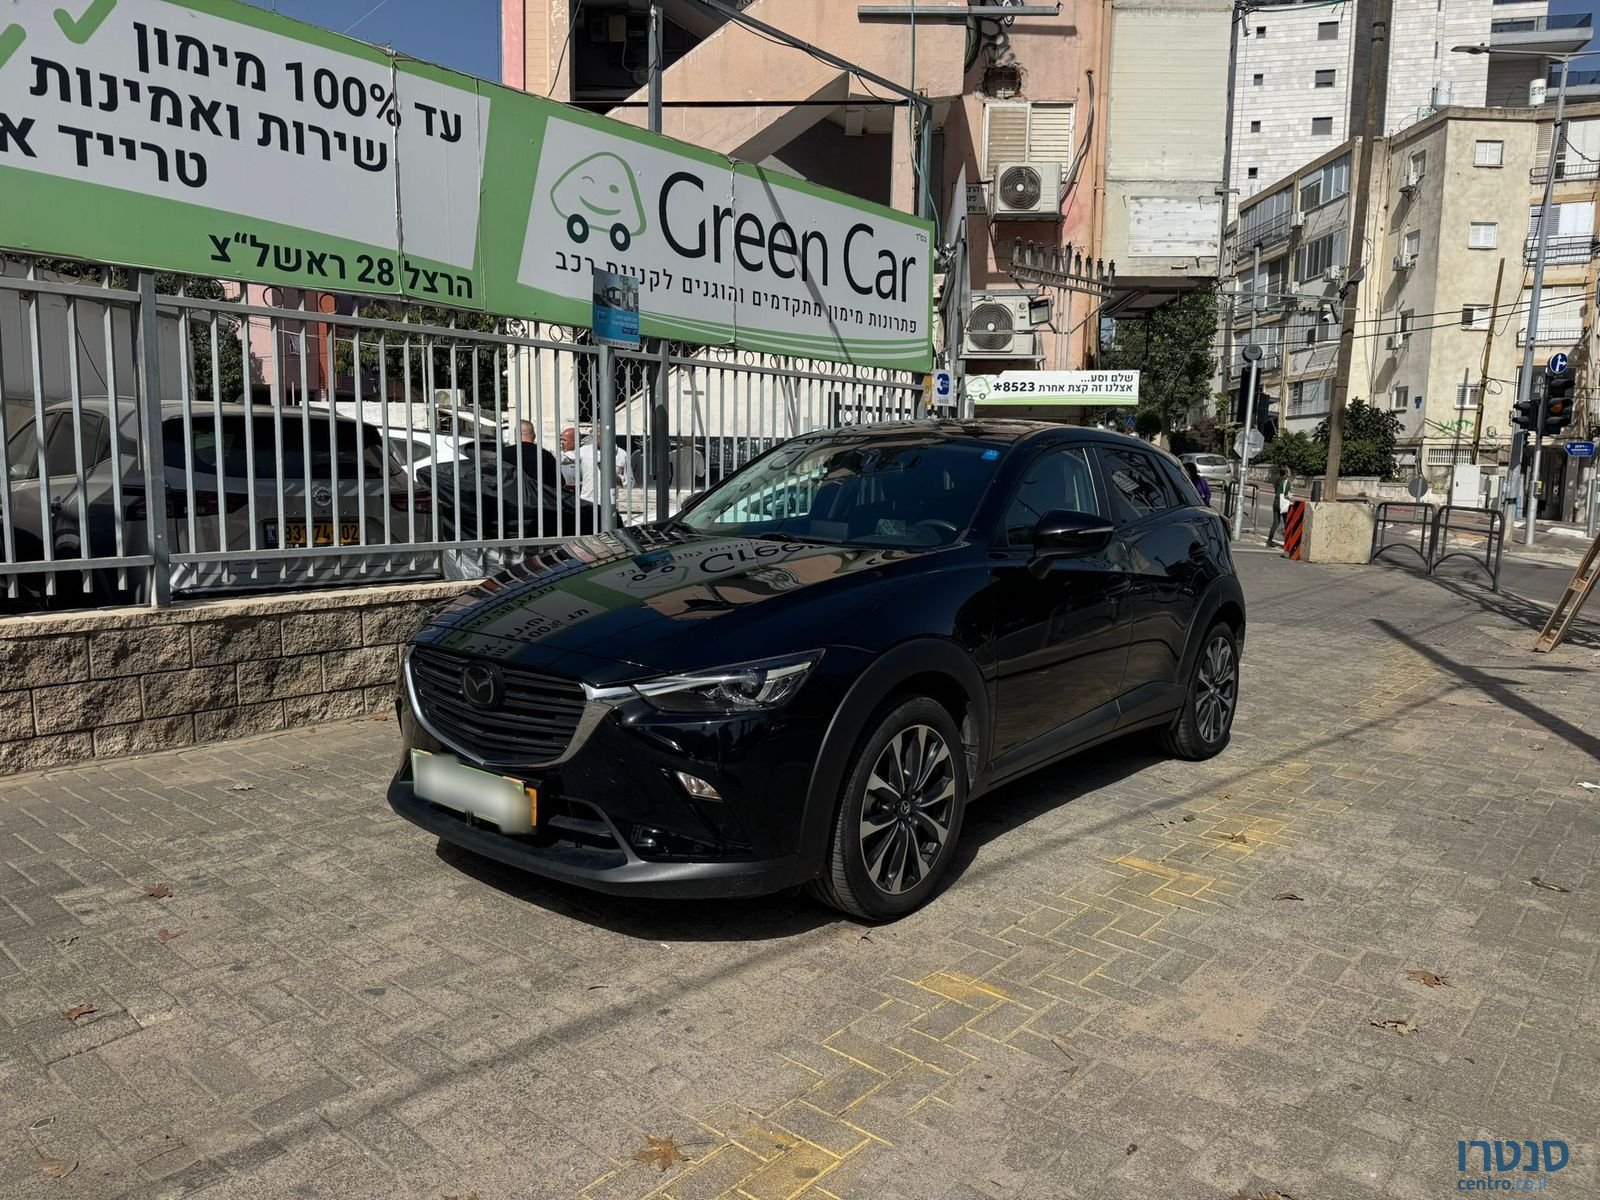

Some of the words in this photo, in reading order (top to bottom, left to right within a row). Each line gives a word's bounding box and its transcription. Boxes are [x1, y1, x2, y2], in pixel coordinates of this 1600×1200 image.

[133, 21, 267, 93] מימון
[29, 56, 240, 140] ואמינות
[285, 62, 402, 127] 100%
[413, 102, 462, 143] עד
[57, 124, 208, 188] טרייד
[257, 112, 388, 172] שירות
[658, 171, 829, 287] Green
[843, 222, 917, 303] Car
[357, 254, 395, 286] 28
[403, 261, 473, 299] הרצל
[682, 276, 745, 304] והוגנים
[752, 290, 823, 318] מתקדמים
[828, 304, 864, 324] מימון
[868, 312, 917, 334] פתרונות
[1038, 384, 1065, 392] אחרת
[1067, 384, 1088, 394] קצת
[1090, 384, 1103, 392] זה
[1105, 382, 1133, 392] אצלנו
[1111, 372, 1134, 383] שלם
